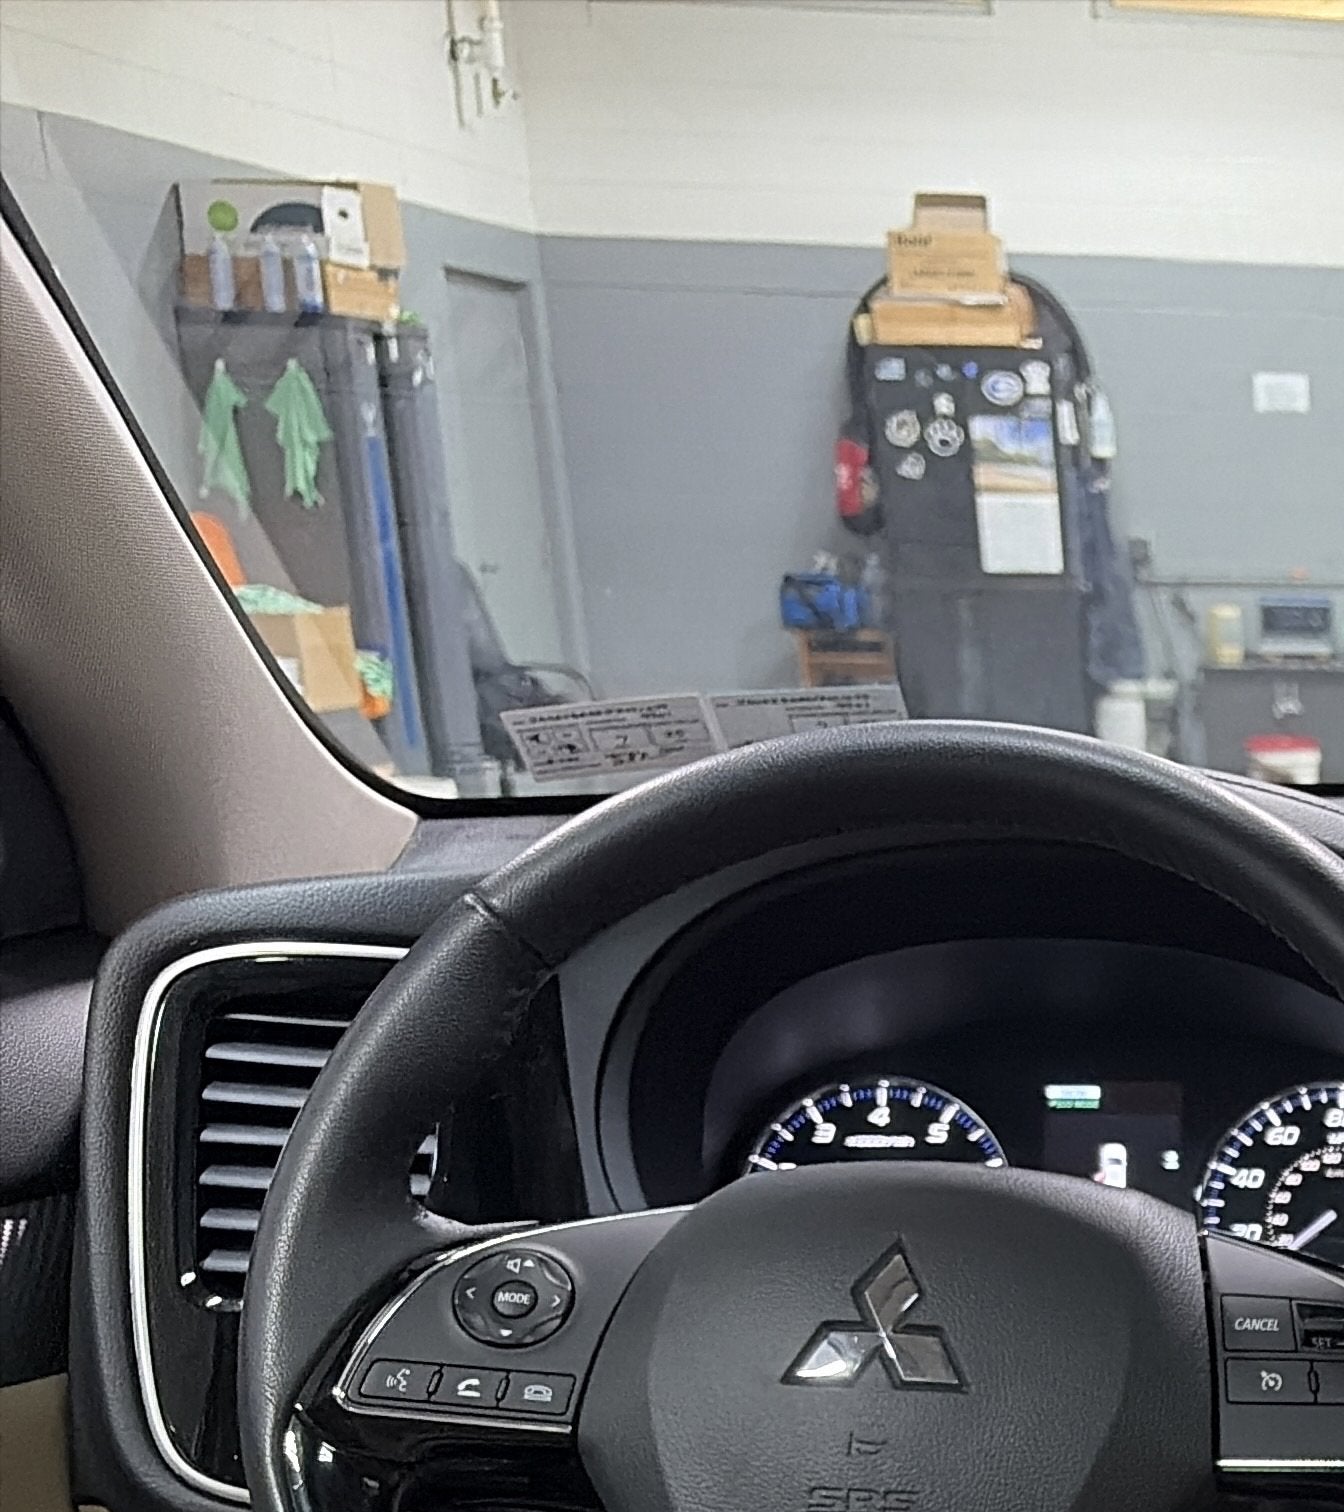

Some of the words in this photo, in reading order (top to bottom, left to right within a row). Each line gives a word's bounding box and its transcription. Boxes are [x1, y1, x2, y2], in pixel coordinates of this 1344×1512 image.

[867, 1107, 891, 1127] 4
[810, 1122, 836, 1144] 3
[925, 1122, 950, 1144] 5
[1264, 1126, 1300, 1146] 60
[1229, 1168, 1265, 1189] 40
[497, 1290, 531, 1305] MODE
[1234, 1317, 1280, 1332] CANCEL
